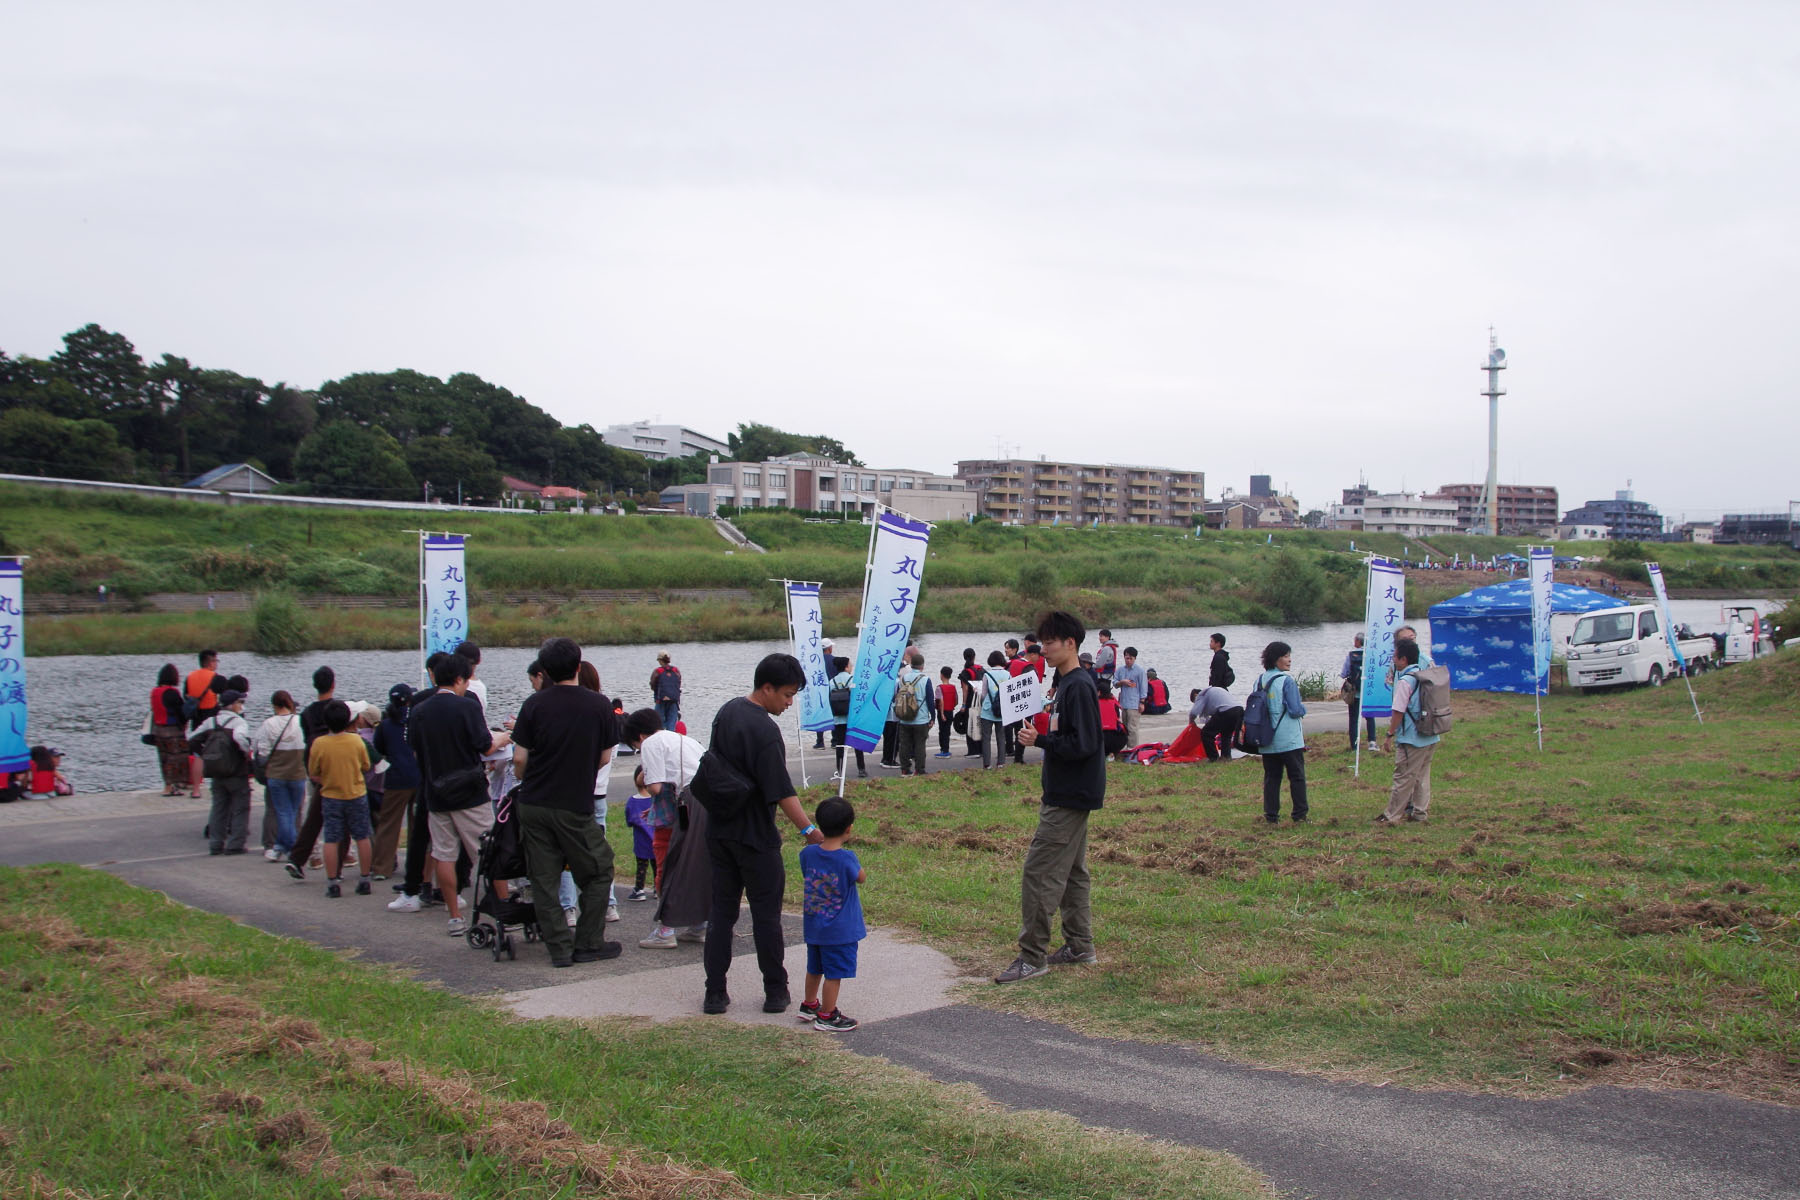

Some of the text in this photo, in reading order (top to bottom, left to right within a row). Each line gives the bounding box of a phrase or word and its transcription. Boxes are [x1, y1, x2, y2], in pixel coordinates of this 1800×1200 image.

[441, 565, 464, 655] 丸子の渡
[805, 608, 829, 709] 丸子の渡し
[852, 604, 882, 714] 丸子の渡し復活協議会
[873, 555, 921, 712] 丸子の渡し
[0, 595, 27, 737] 丸子の渡し
[1010, 689, 1032, 704] 最後尾は
[1014, 702, 1029, 713] こちら
